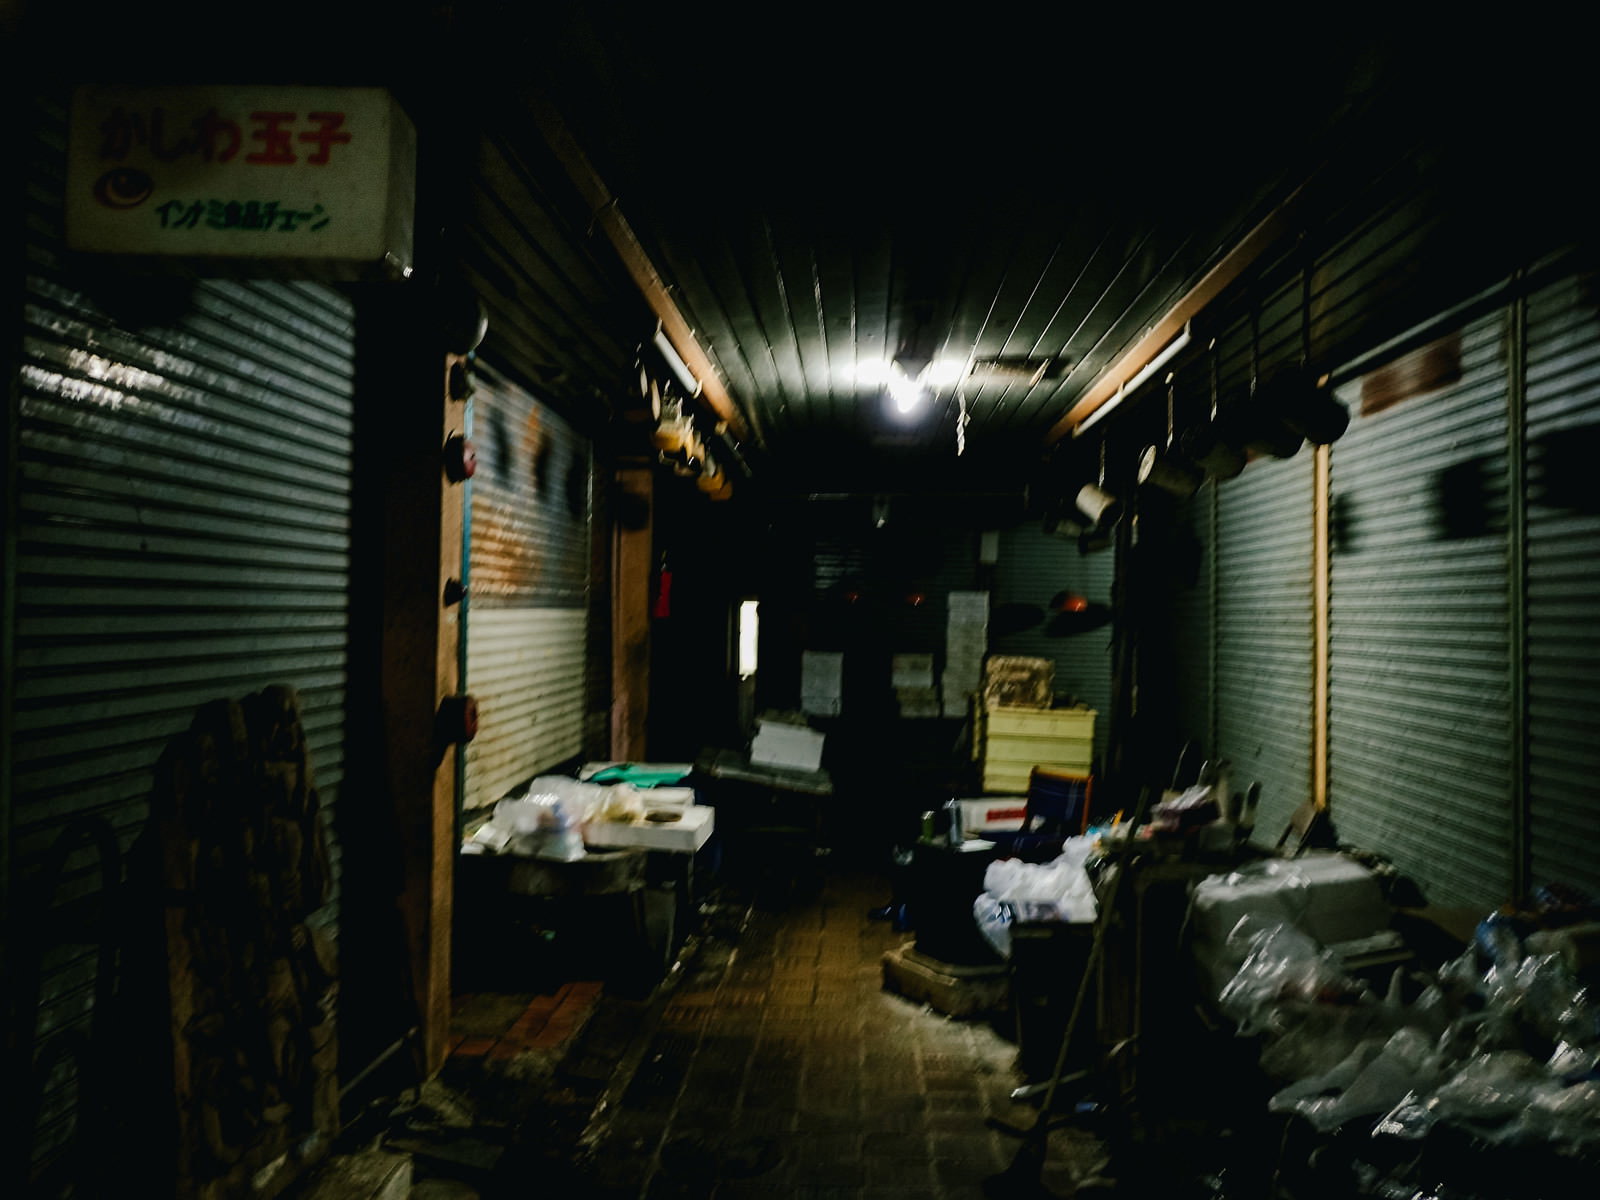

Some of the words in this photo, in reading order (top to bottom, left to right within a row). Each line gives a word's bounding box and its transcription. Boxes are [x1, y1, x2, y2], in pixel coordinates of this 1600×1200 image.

[99, 107, 352, 166] かしわ玉子
